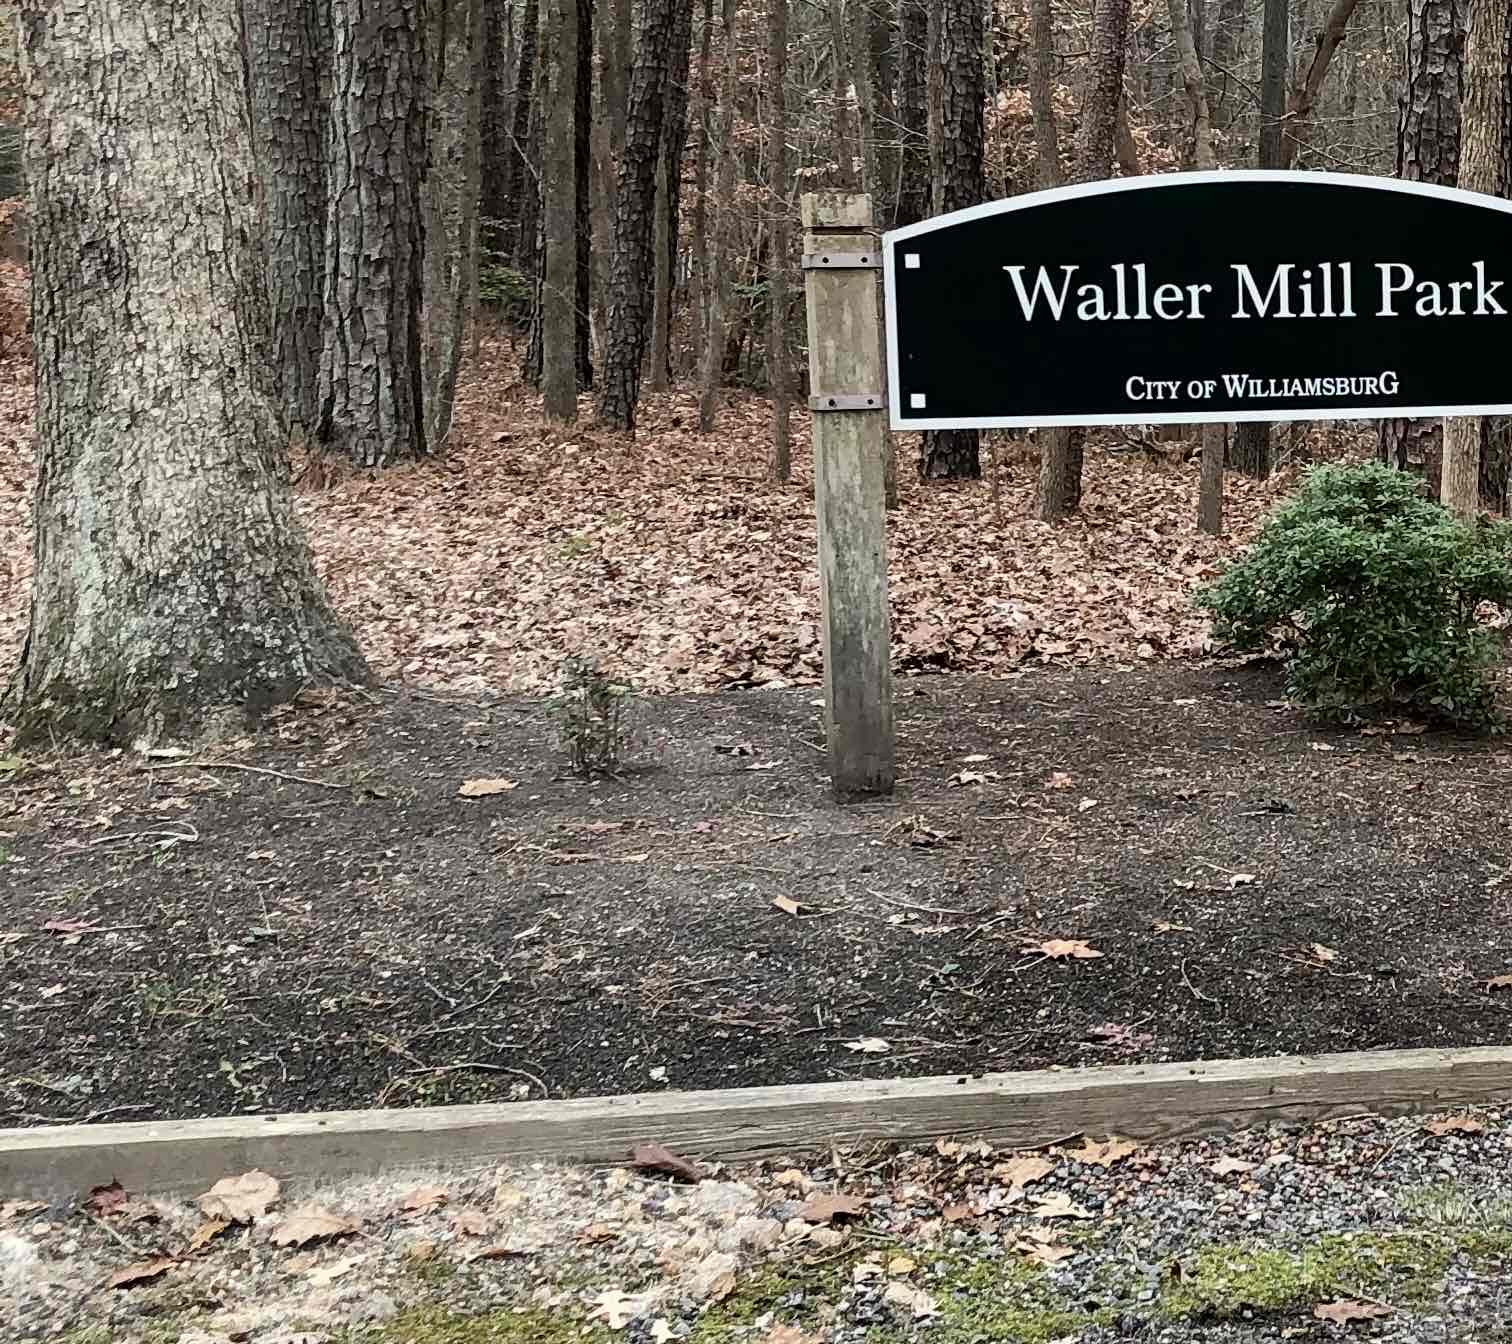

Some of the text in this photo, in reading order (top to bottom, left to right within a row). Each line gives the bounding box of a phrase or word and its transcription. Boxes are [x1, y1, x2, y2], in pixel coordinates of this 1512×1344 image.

[1002, 260, 1508, 322] Waller Mill Park
